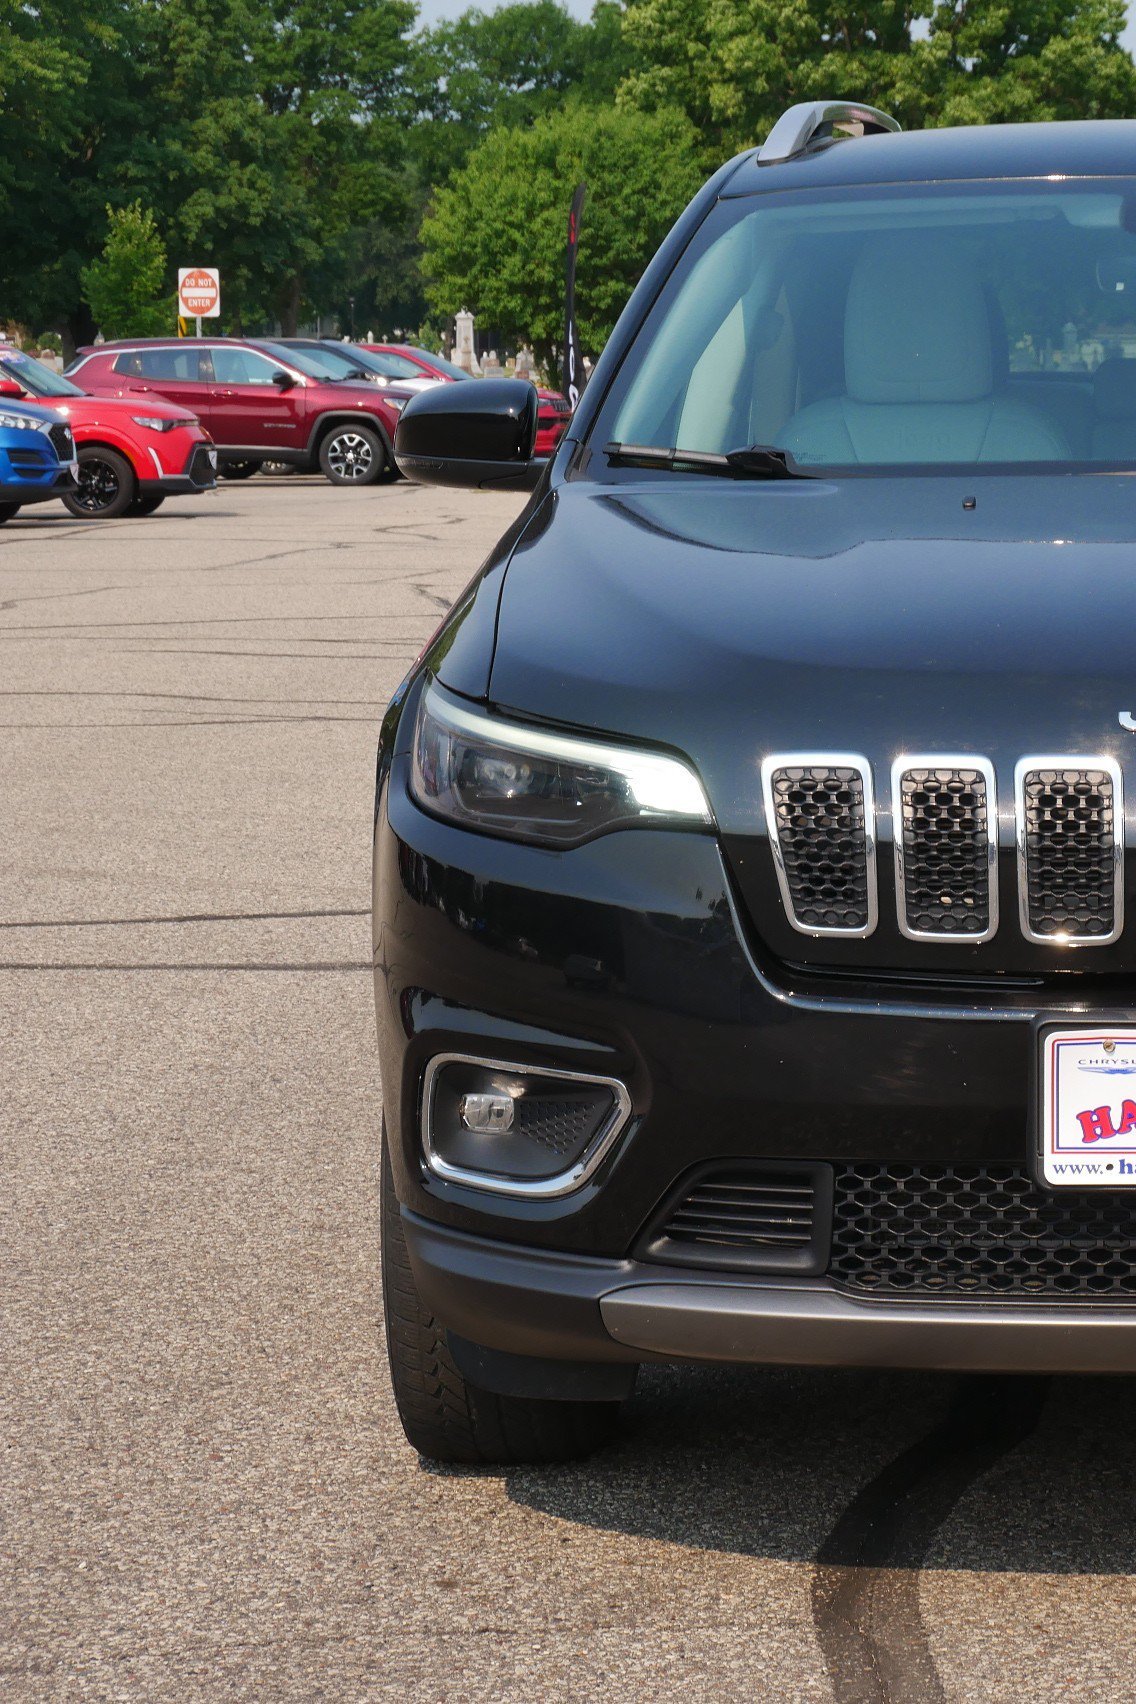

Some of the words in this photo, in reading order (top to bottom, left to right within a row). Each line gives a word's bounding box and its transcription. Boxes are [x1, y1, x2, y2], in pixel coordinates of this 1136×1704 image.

[185, 279, 195, 287] DO
[198, 279, 212, 287] NOT
[187, 299, 211, 307] ENTER
